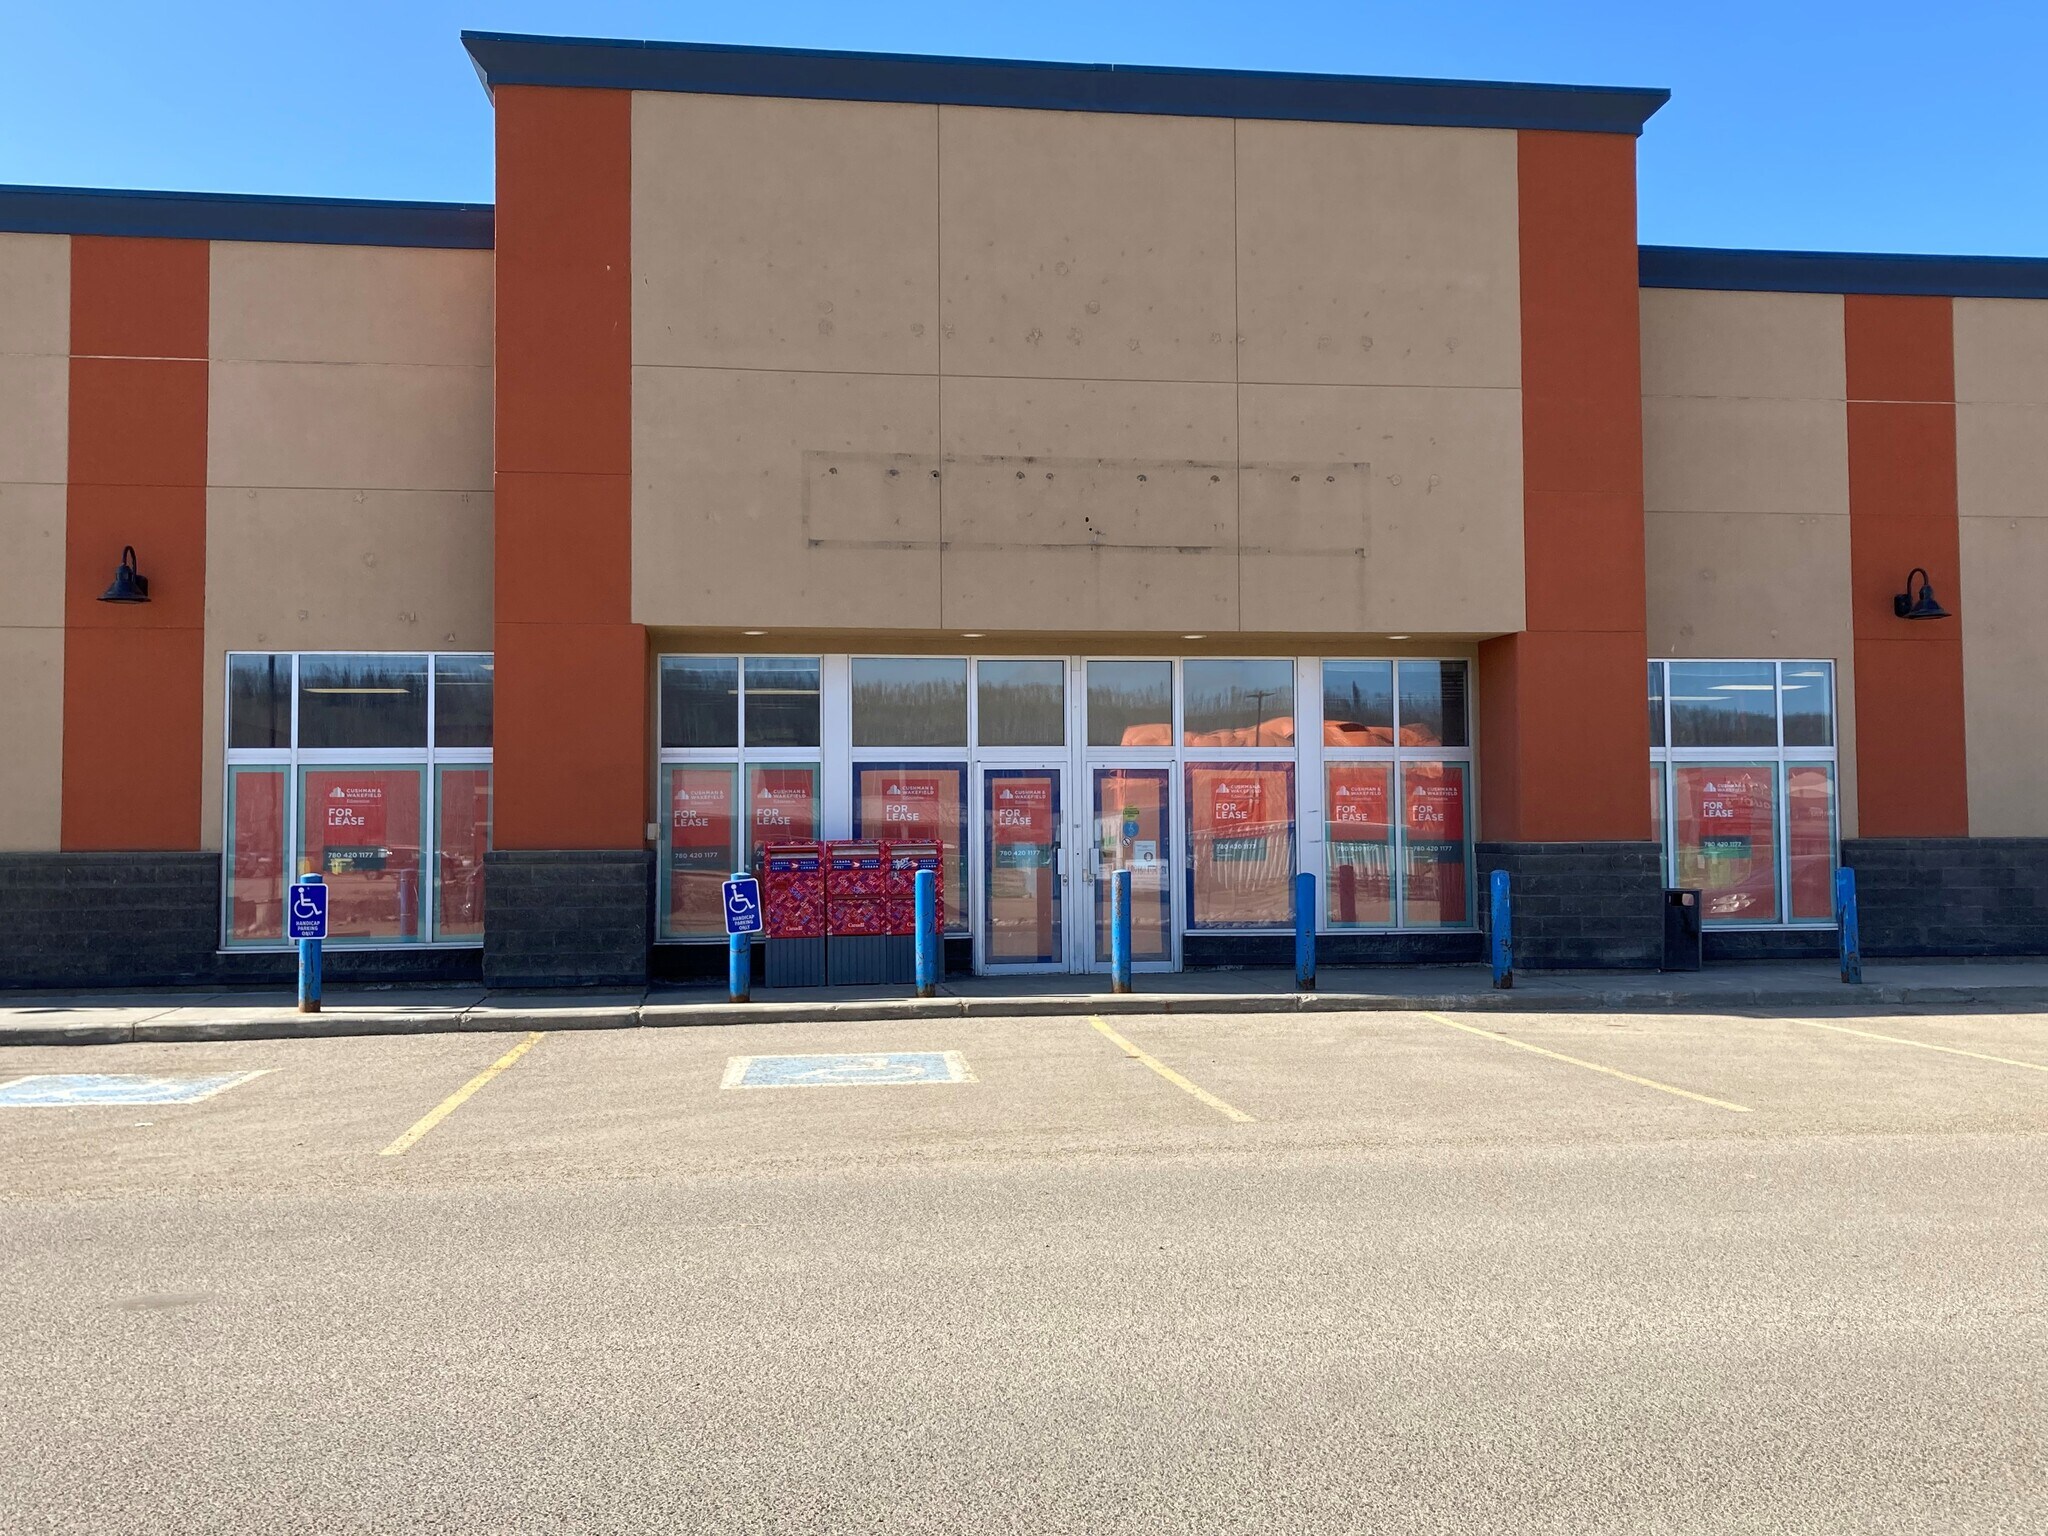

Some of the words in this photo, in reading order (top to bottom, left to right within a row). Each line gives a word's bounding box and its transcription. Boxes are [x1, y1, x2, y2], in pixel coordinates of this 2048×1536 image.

[886, 804, 908, 813] FOR
[1216, 803, 1237, 812] FOR
[1336, 805, 1357, 814] FOR
[1412, 805, 1433, 814] FOR
[1703, 802, 1723, 810] FOR
[328, 808, 353, 817] FOR
[674, 810, 697, 818] FOR
[756, 808, 779, 817] FOR
[886, 812, 920, 822] LEASE
[999, 808, 1020, 818] FOR
[1216, 811, 1248, 819] LEASE
[1703, 810, 1734, 818] LEASE
[328, 817, 365, 826] LEASE
[756, 816, 791, 825] LEASE
[999, 817, 1032, 826] LEASE
[1336, 814, 1368, 822] LEASE
[1412, 813, 1444, 822] LEASE
[674, 818, 709, 827] LEASE
